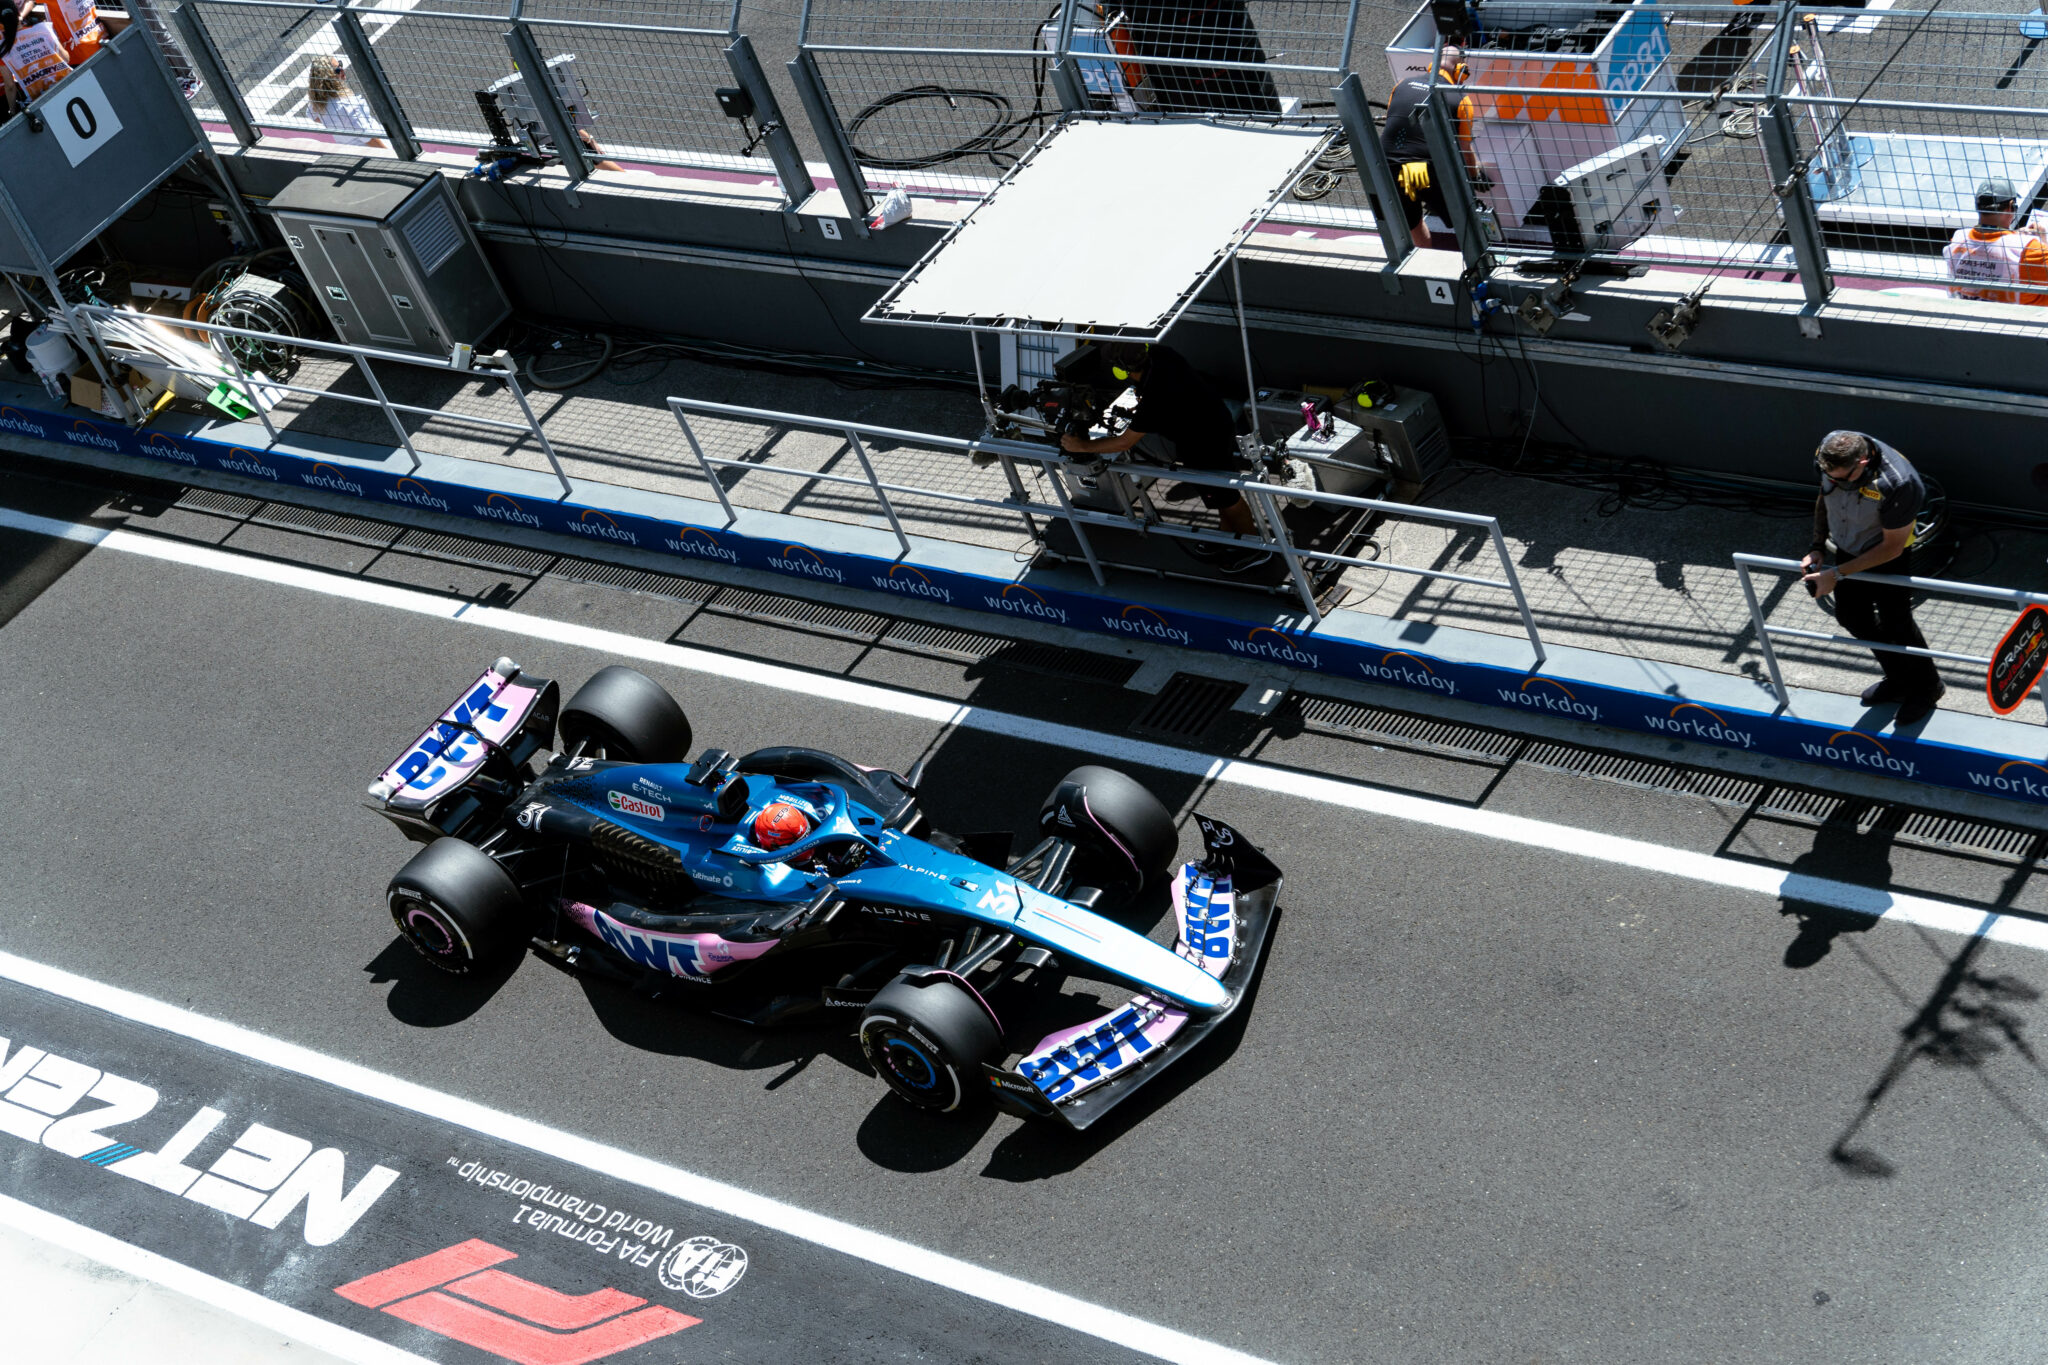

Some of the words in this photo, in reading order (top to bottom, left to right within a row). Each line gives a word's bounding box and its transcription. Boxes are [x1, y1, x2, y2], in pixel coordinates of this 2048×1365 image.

[66, 97, 97, 139] 0
[825, 223, 835, 235] 5
[1435, 286, 1446, 299] 4
[1996, 616, 2041, 678] ORACLE
[396, 683, 508, 790] BWT
[639, 777, 663, 792] RENAULT
[517, 802, 552, 833] 31
[620, 795, 662, 818] Castrol
[1202, 820, 1234, 846] plug
[692, 872, 721, 884] ultimate
[900, 864, 948, 880] ALPINE
[976, 879, 1018, 916] 31
[861, 905, 932, 922] ALPINE
[593, 909, 703, 978] BWT
[1001, 1080, 1034, 1094] Microsoft
[103, 1105, 401, 1247] NET
[457, 1161, 607, 1224] Championship
[512, 1203, 531, 1224] 1
[528, 1210, 620, 1255] Formula
[604, 1211, 675, 1248] World
[618, 1238, 663, 1268] FIA
